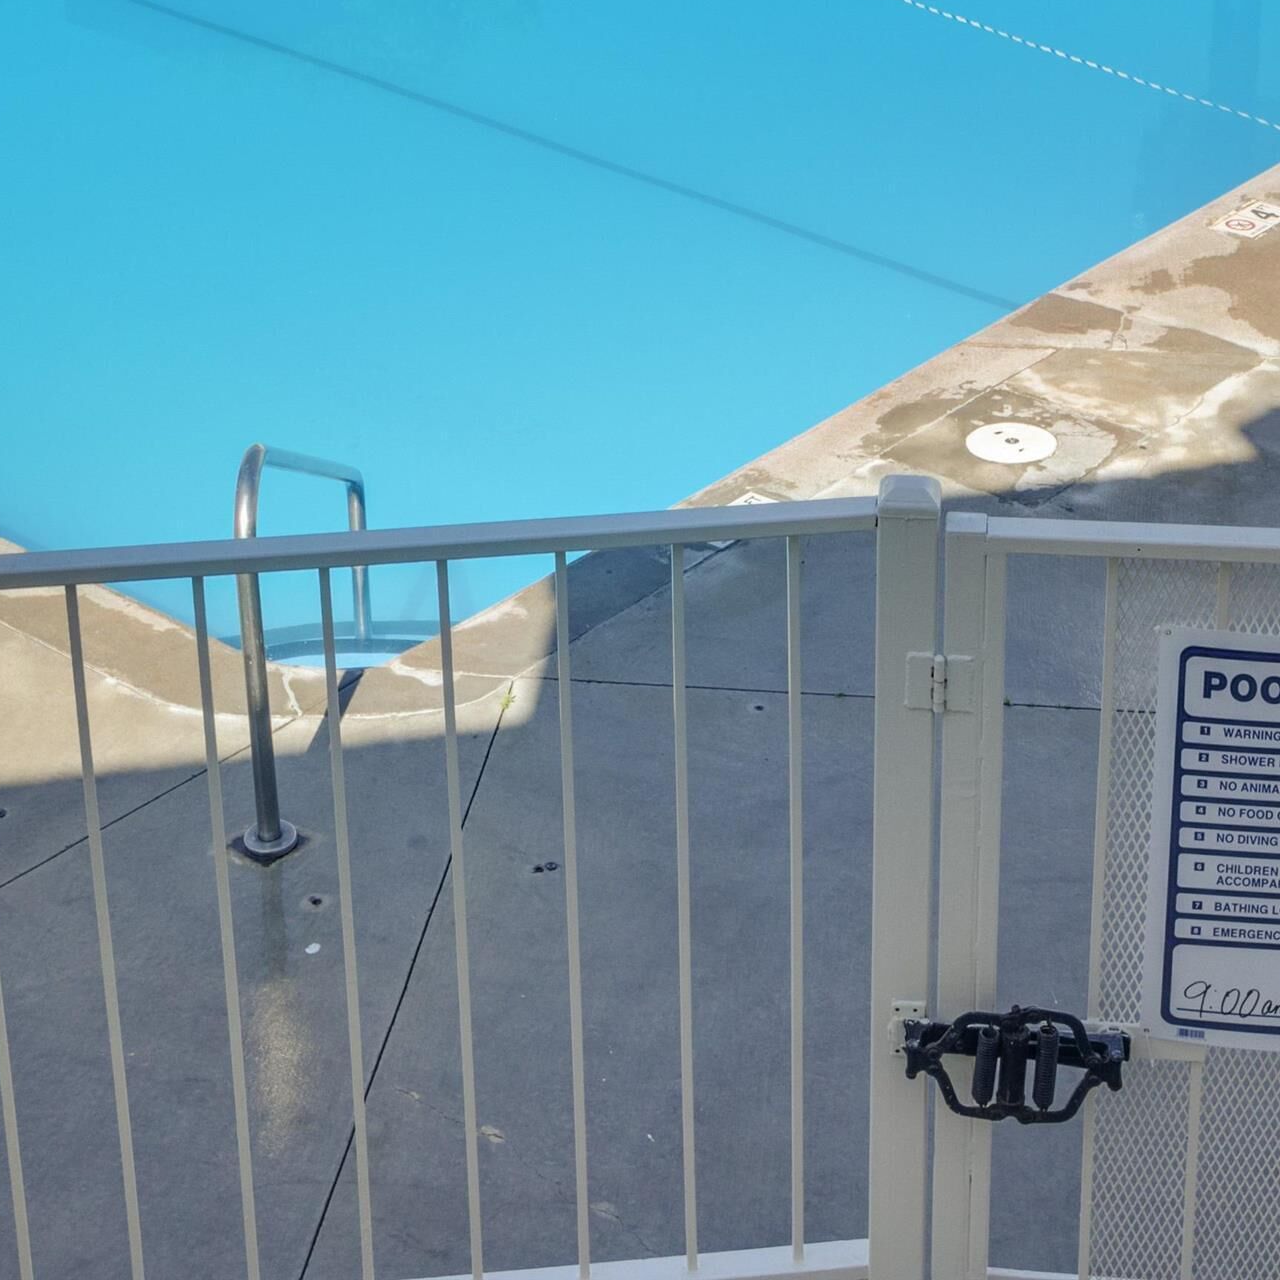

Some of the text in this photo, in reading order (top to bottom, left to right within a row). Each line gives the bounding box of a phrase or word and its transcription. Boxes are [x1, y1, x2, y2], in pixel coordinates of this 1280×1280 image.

[1221, 754, 1276, 768] SHOWER
[1219, 780, 1238, 791] NO
[1218, 807, 1235, 818] NO
[1238, 808, 1273, 820] FOOD
[1216, 833, 1234, 844] NO
[1237, 834, 1279, 847] DIVING
[1216, 863, 1279, 877] CHILDREN
[1214, 902, 1268, 915] BATHING
